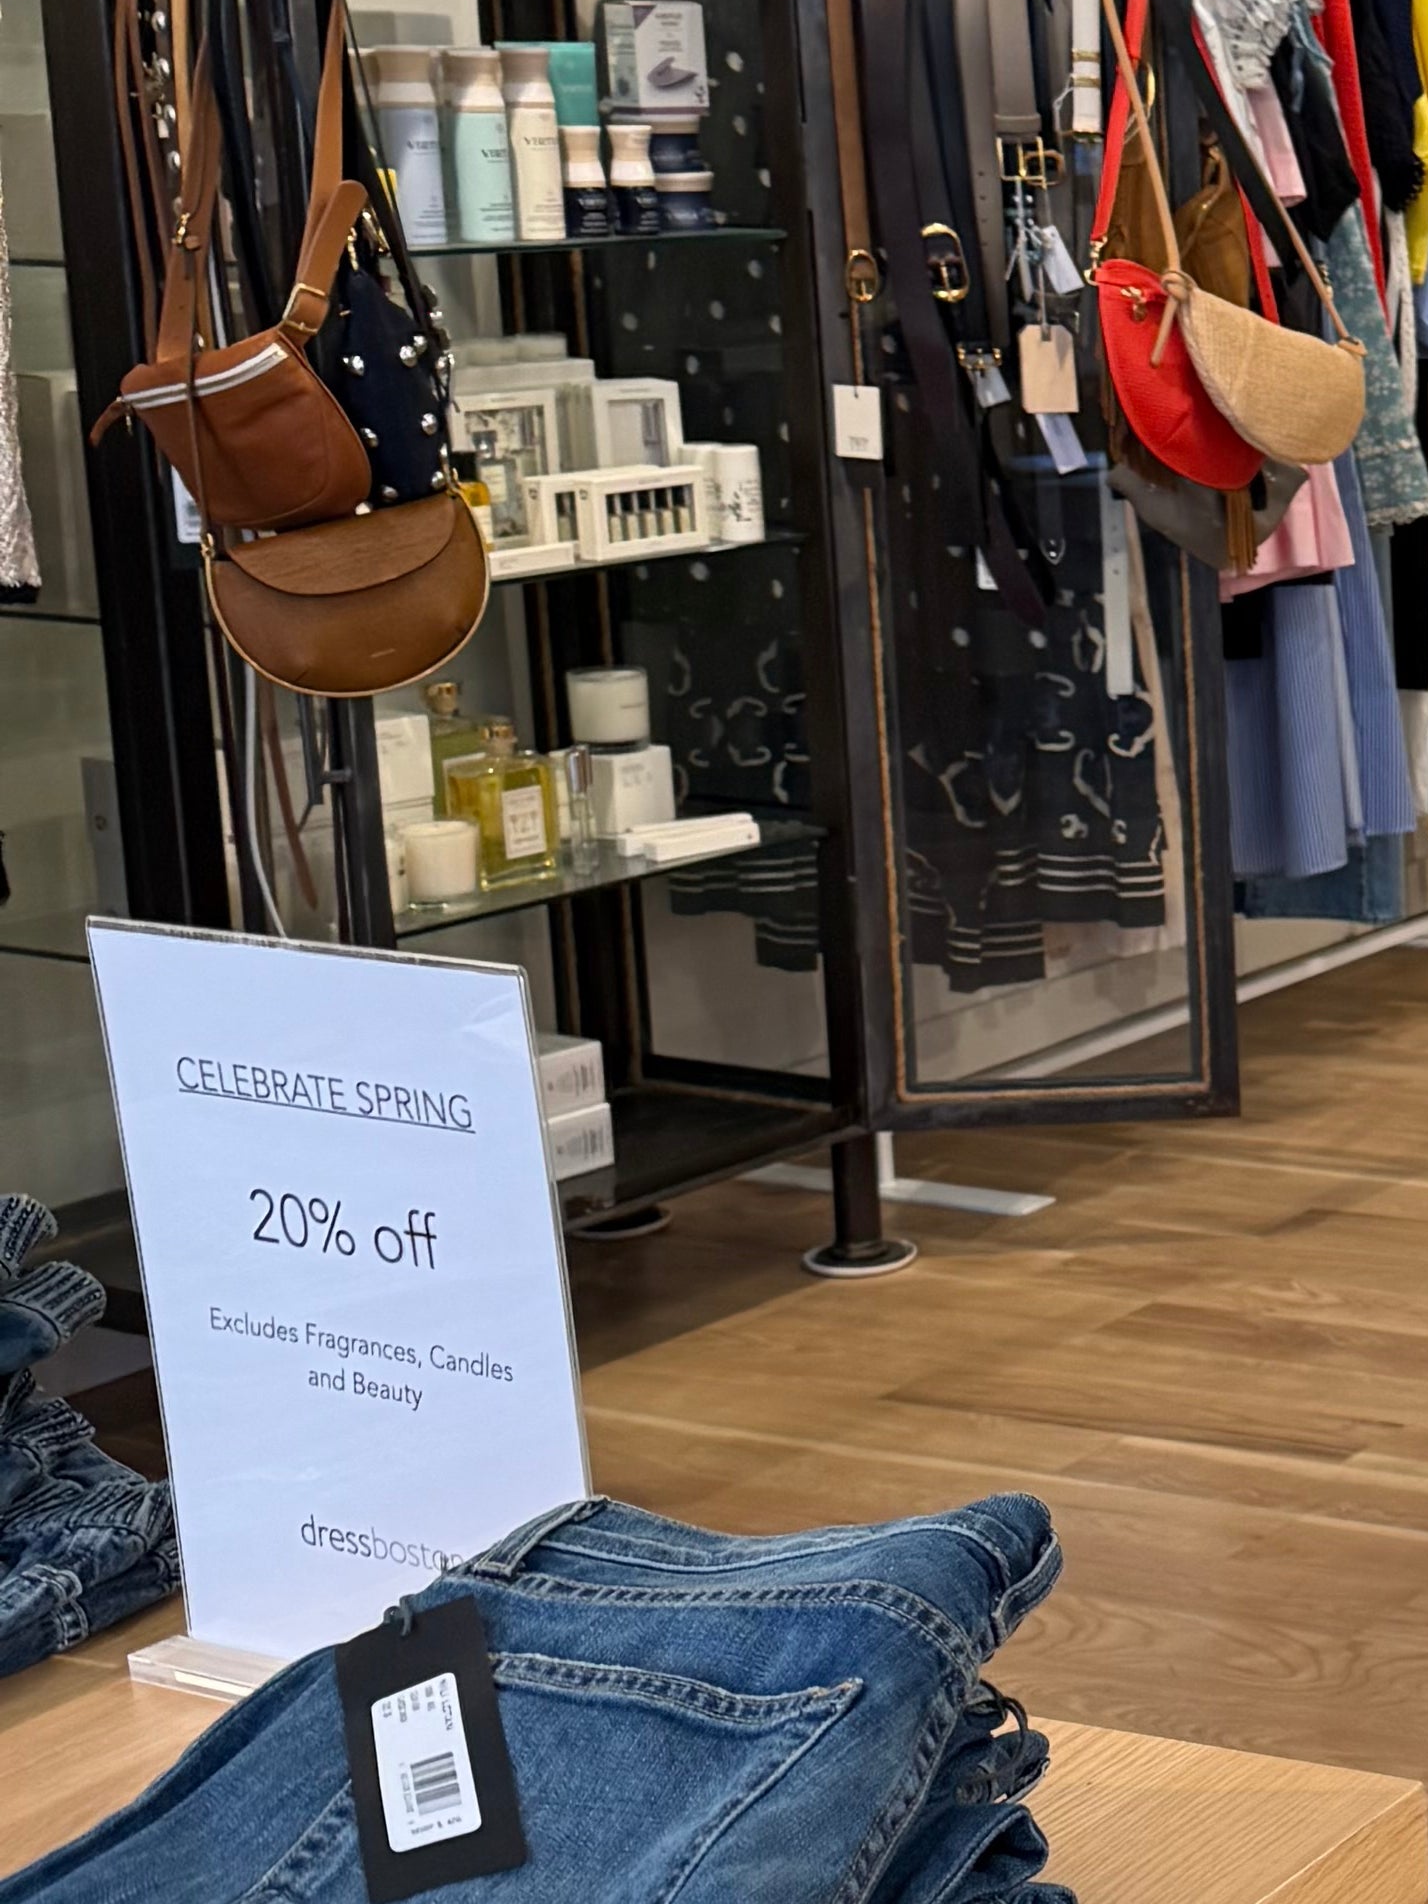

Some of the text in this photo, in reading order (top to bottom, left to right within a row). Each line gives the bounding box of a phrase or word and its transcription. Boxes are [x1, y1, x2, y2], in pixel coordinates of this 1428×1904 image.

[176, 1056, 473, 1130] CELEBRATE SPRING
[249, 1188, 438, 1270] 20% off
[209, 1307, 515, 1382] Excludes Fragrances, Candles
[308, 1367, 423, 1411] and Beauty
